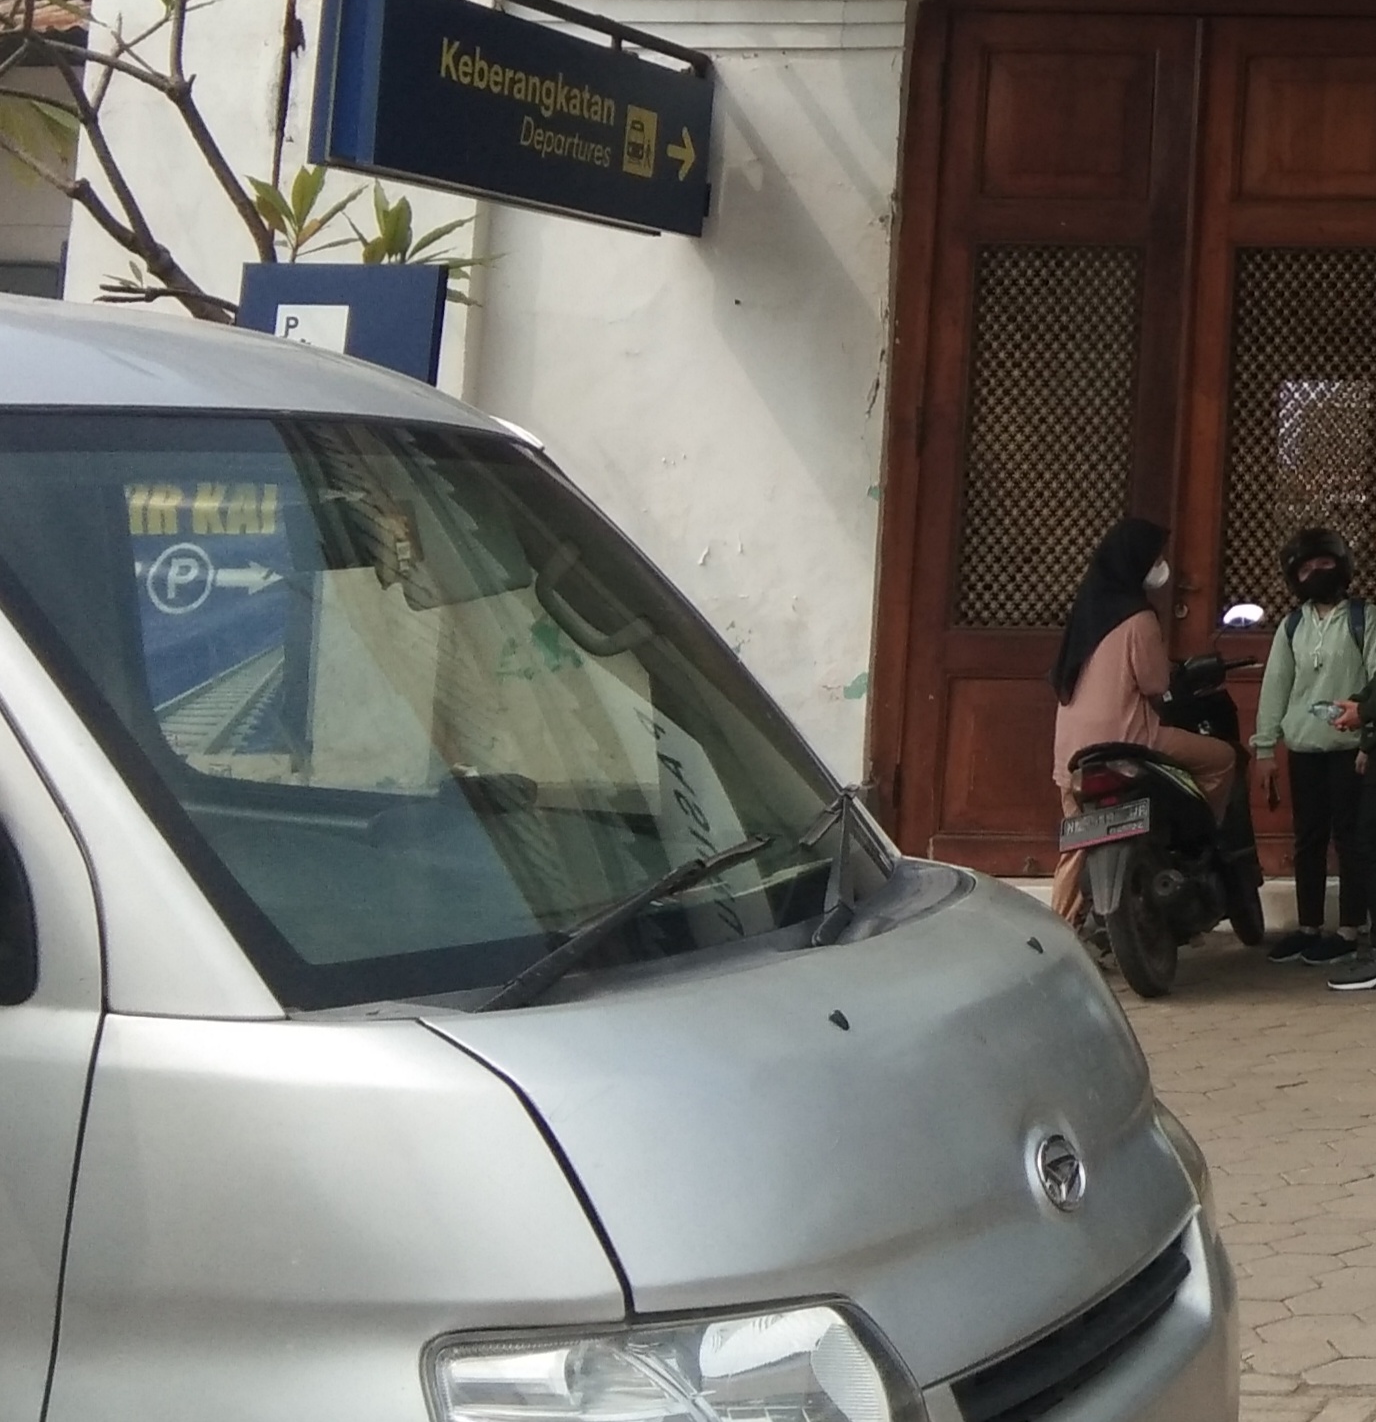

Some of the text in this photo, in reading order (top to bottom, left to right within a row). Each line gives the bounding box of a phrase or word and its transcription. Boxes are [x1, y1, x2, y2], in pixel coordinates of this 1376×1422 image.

[440, 37, 615, 126] Keberangkatan
[520, 116, 612, 168] Departures
[192, 483, 278, 535] KAI
